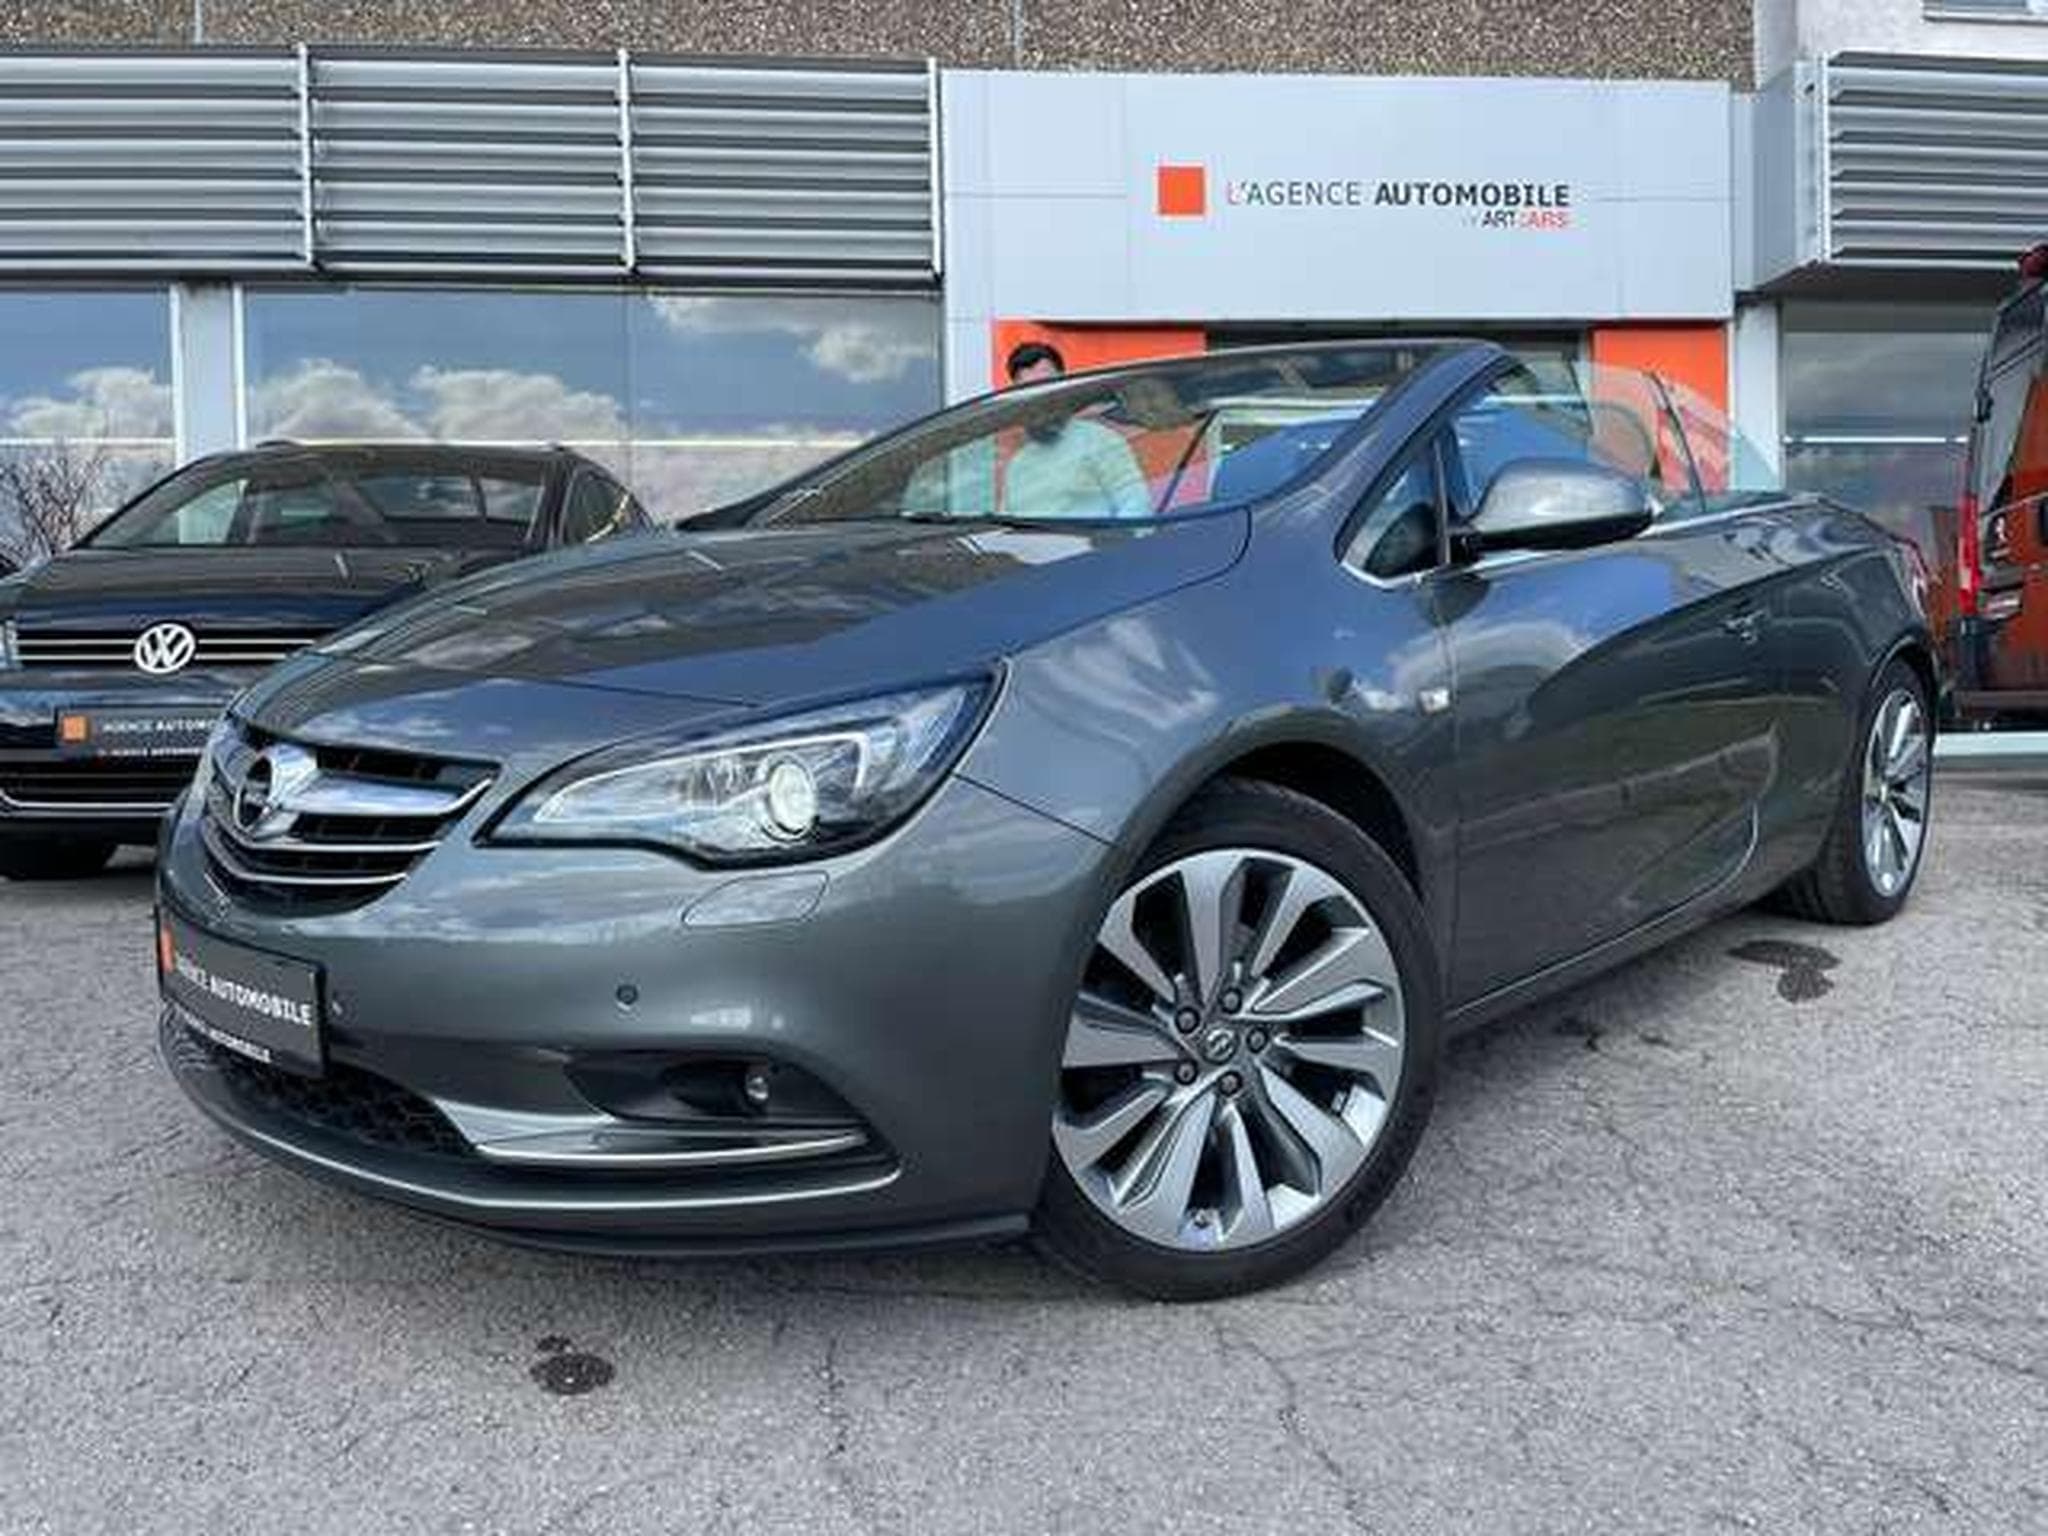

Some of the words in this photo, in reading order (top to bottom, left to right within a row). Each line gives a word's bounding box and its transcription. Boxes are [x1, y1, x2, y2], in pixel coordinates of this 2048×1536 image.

[1226, 181, 1361, 206] L'AGENCE
[1374, 182, 1570, 207] AUTOMOBILE
[134, 623, 196, 674] VW
[210, 975, 313, 1027] AUTOMOBILE
